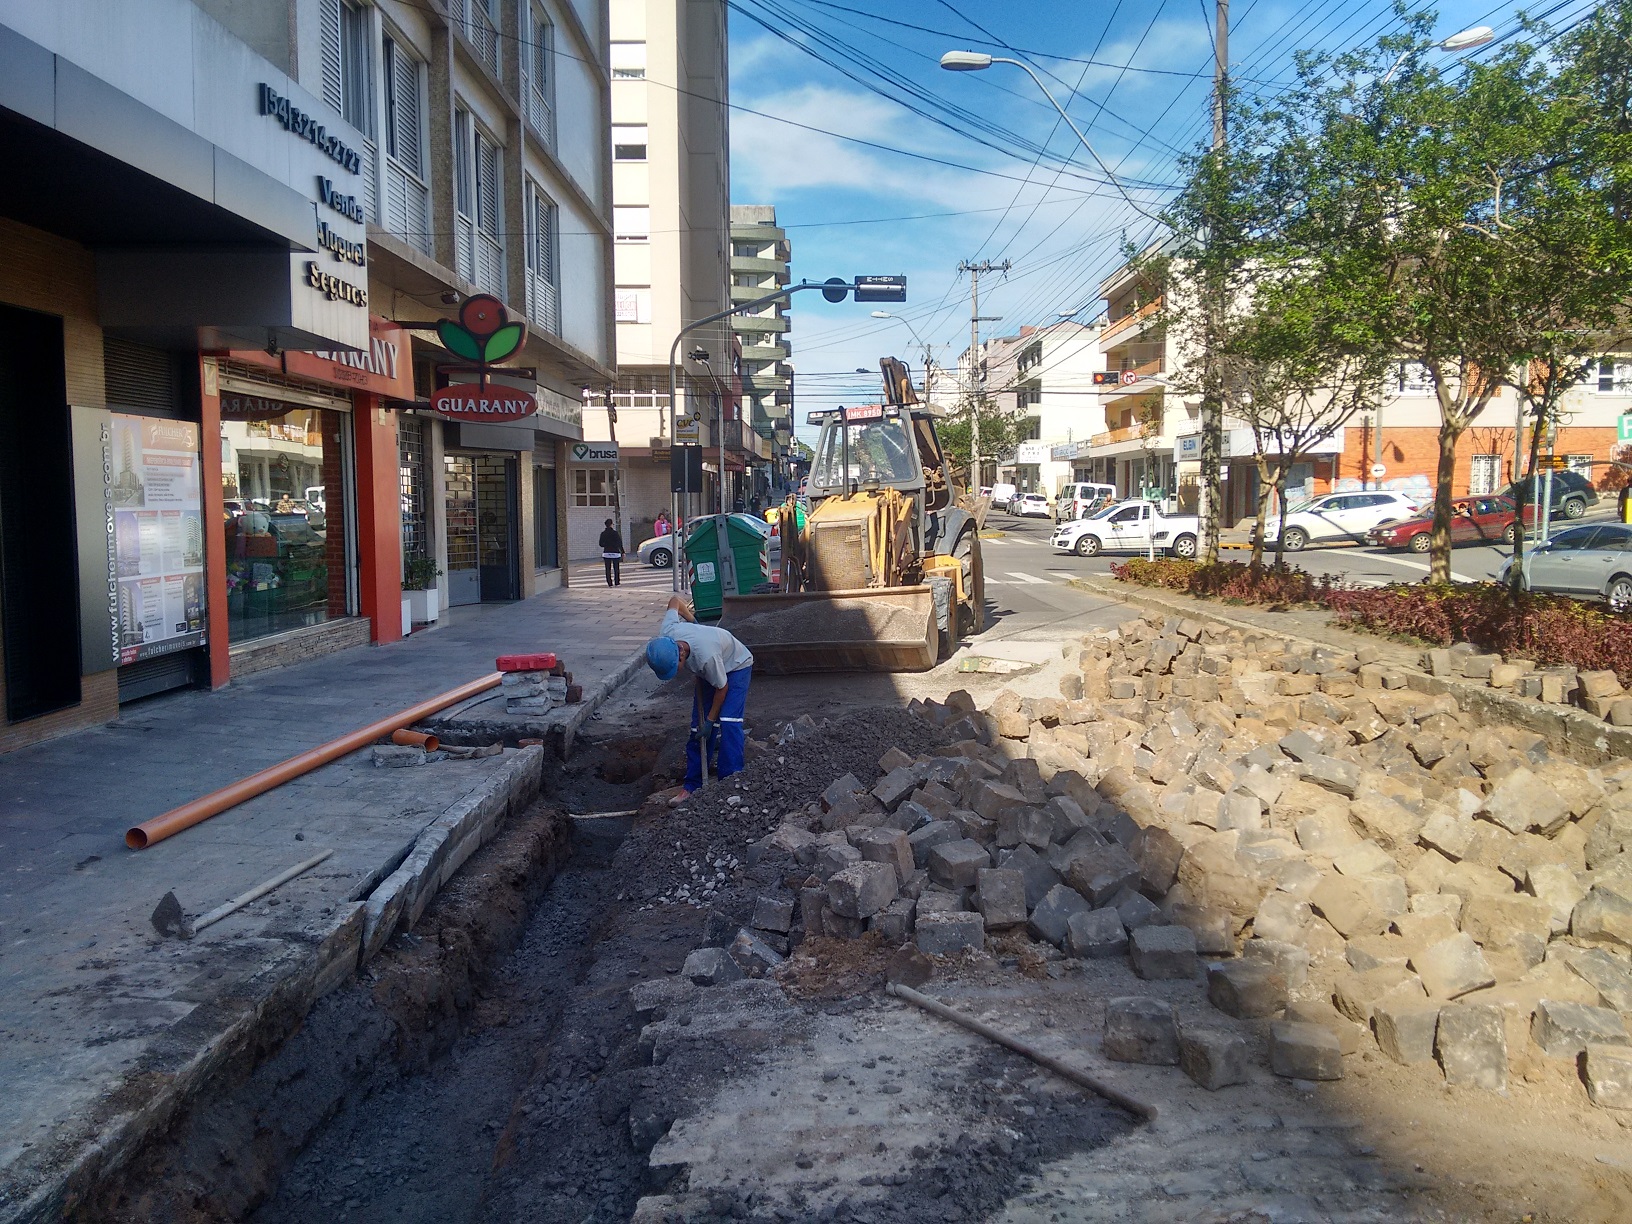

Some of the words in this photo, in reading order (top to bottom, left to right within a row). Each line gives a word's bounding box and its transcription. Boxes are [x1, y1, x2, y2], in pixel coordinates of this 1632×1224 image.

[316, 175, 364, 224] Venda
[316, 217, 366, 267] Aluguel
[307, 261, 367, 307] Seguros
[437, 397, 530, 415] GUARANY
[589, 448, 618, 459] brusa
